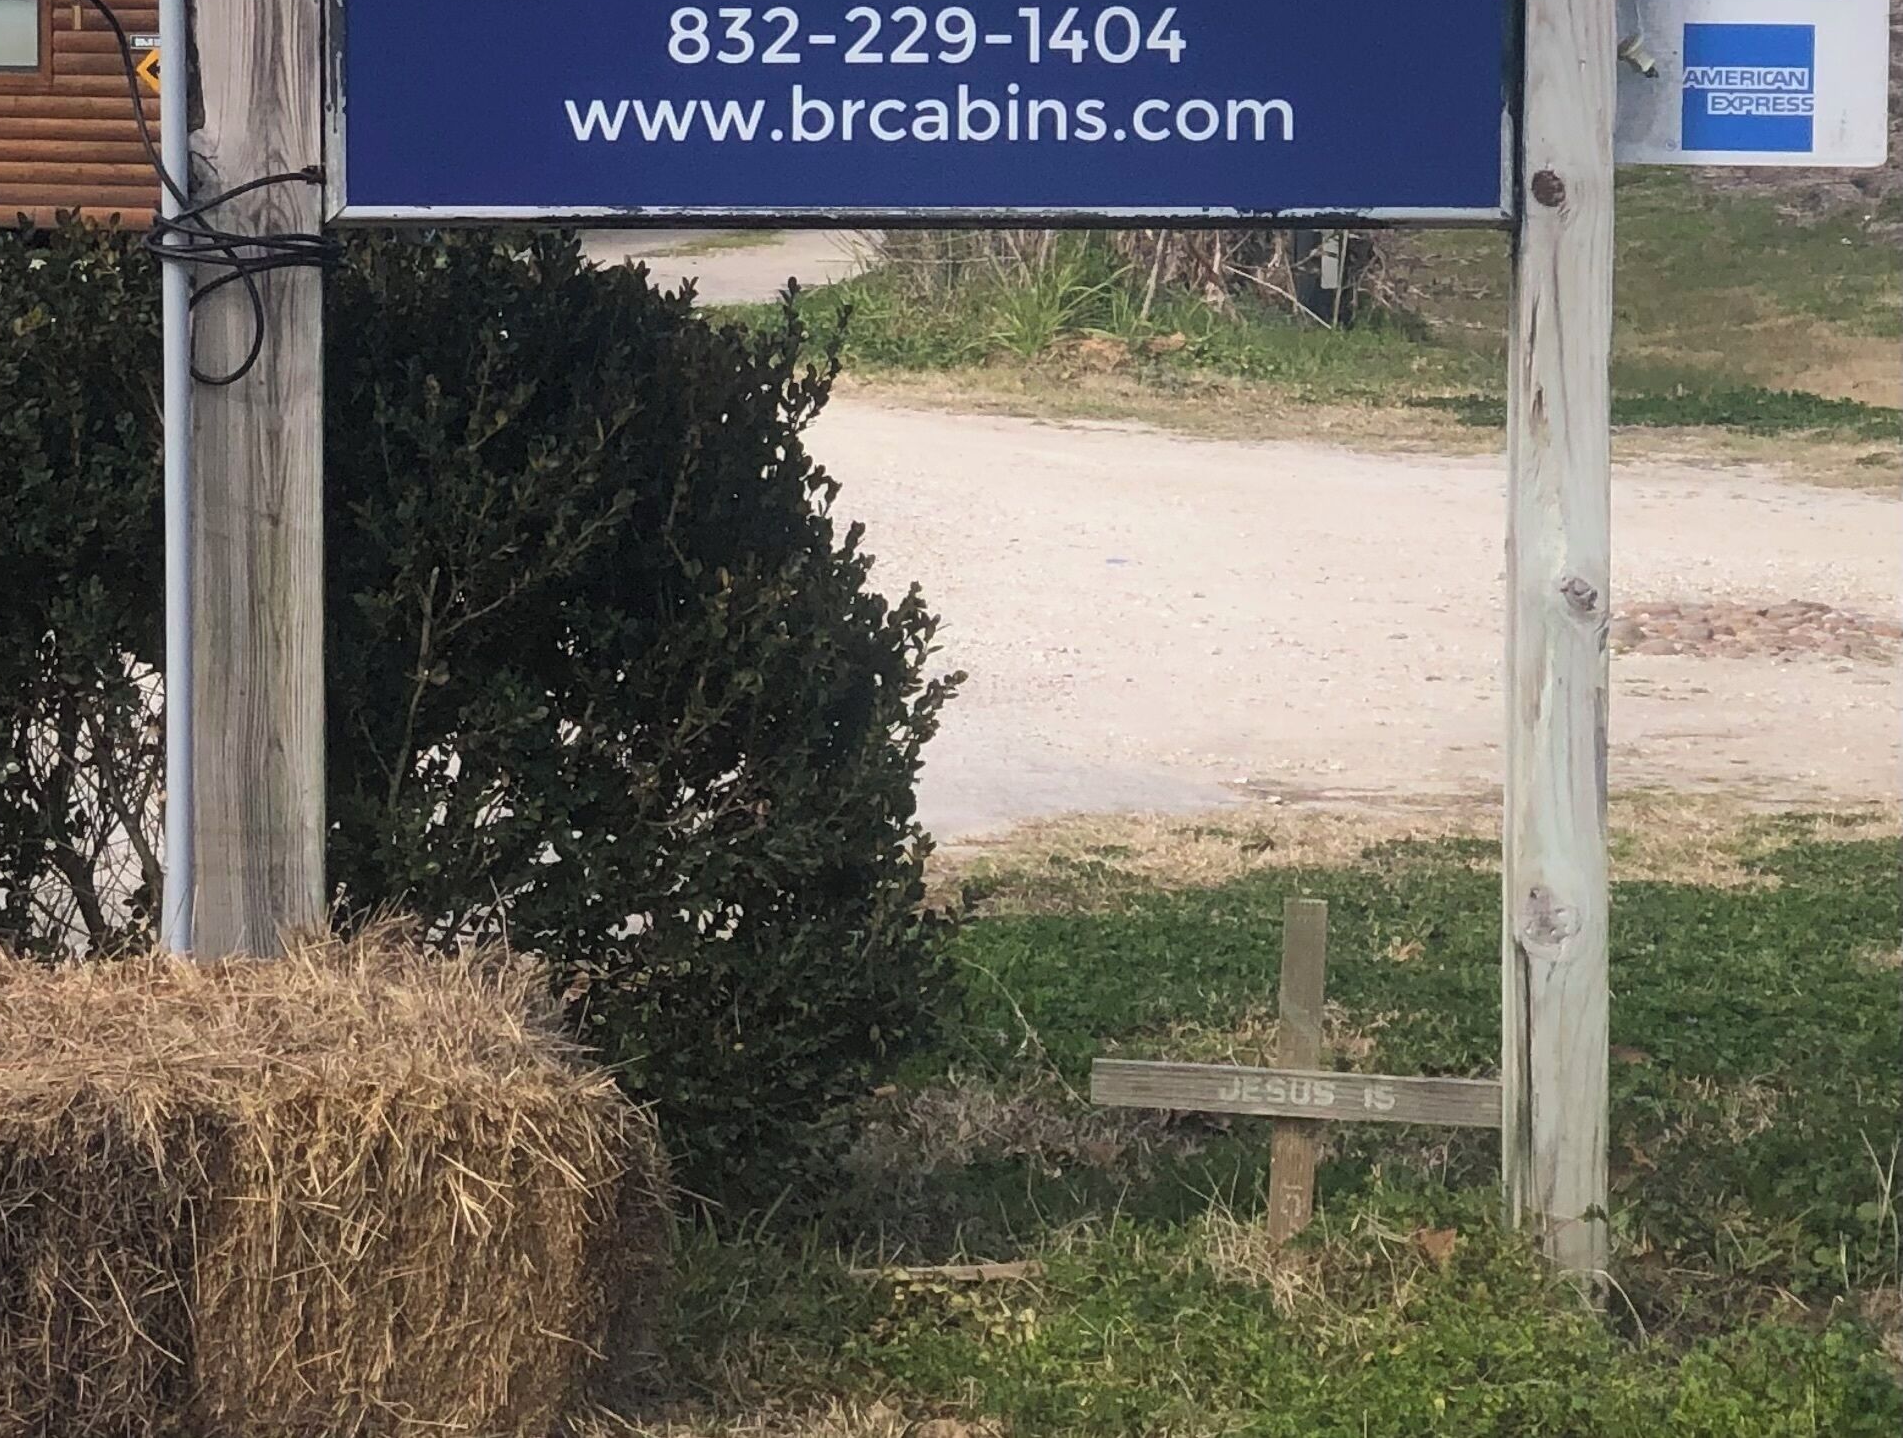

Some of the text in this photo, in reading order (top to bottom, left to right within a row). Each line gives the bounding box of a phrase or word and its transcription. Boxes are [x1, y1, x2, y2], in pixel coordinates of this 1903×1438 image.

[669, 7, 1186, 63] 832-229-1404
[1683, 70, 1805, 86] AMERICAN
[565, 84, 1293, 141] www.brcabins.com
[1711, 96, 1814, 112] EXPRESS
[1218, 1076, 1395, 1110] JESUS IS
